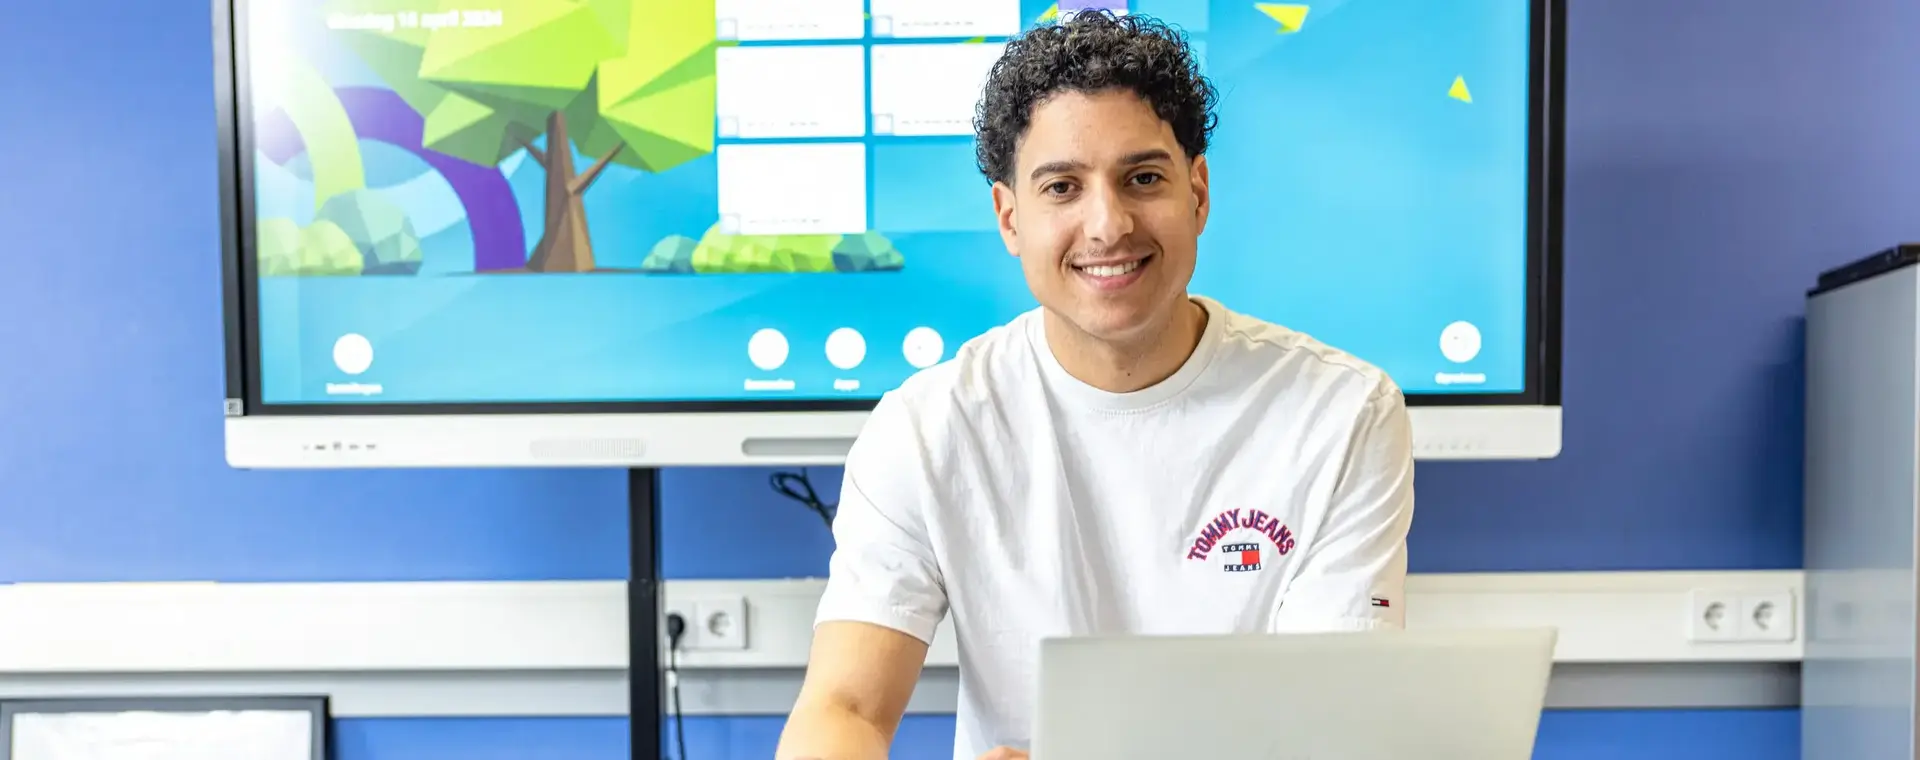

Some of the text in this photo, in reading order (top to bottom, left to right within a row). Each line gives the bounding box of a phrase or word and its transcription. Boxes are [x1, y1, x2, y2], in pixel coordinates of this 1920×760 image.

[1187, 508, 1295, 561] TOMMY JEANS
[1223, 544, 1259, 552] TOMMY
[1225, 563, 1260, 571] JEANS
